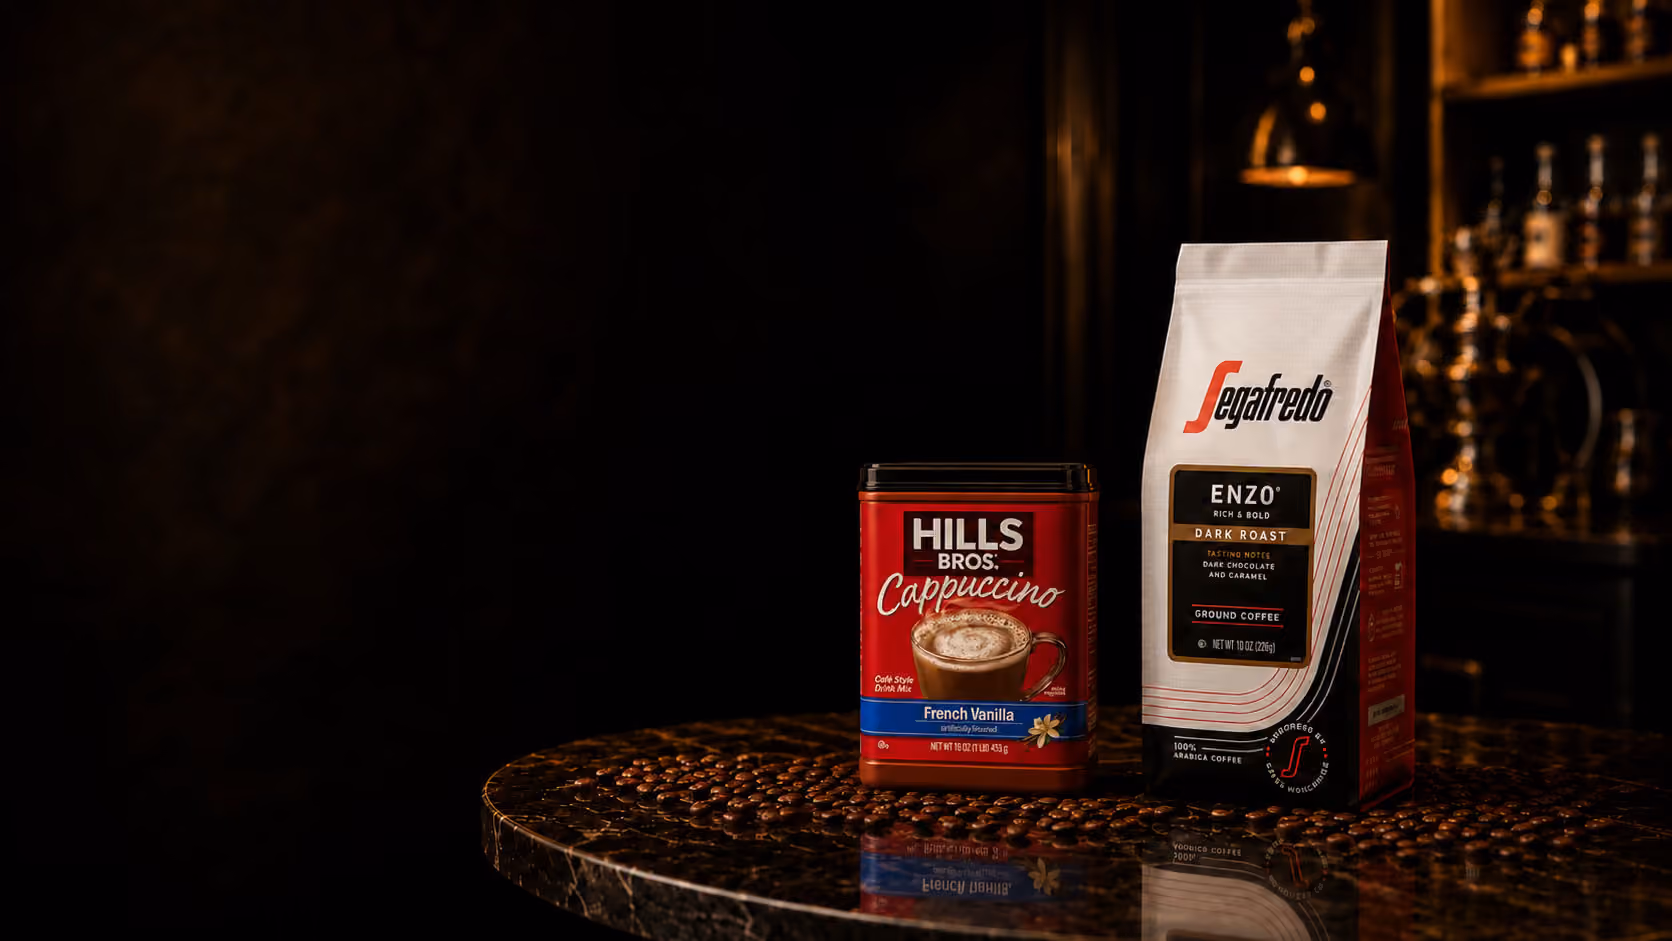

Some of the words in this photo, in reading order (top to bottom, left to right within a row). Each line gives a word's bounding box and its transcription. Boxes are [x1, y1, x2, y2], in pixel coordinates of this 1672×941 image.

[1183, 360, 1333, 433] Segafredo
[1211, 484, 1275, 506] ENZO
[1213, 510, 1234, 518] RICH
[1236, 510, 1243, 519] &
[1246, 511, 1270, 520] BOLD
[912, 517, 1024, 552] HILLS
[1195, 528, 1233, 540] DARK
[1240, 529, 1287, 542] ROAST
[1227, 562, 1276, 571] CHOCOLATE
[1208, 571, 1226, 579] AND
[1228, 572, 1268, 581] CARAMEL
[876, 571, 1067, 616] Cappuccino
[1194, 609, 1237, 620] GROUND
[1240, 611, 1280, 622] COFFEE
[1212, 639, 1225, 650] NET
[923, 706, 968, 721] French
[970, 707, 1015, 722] Vanilla
[1173, 742, 1197, 752] 100%
[1210, 755, 1243, 764] COFFEE
